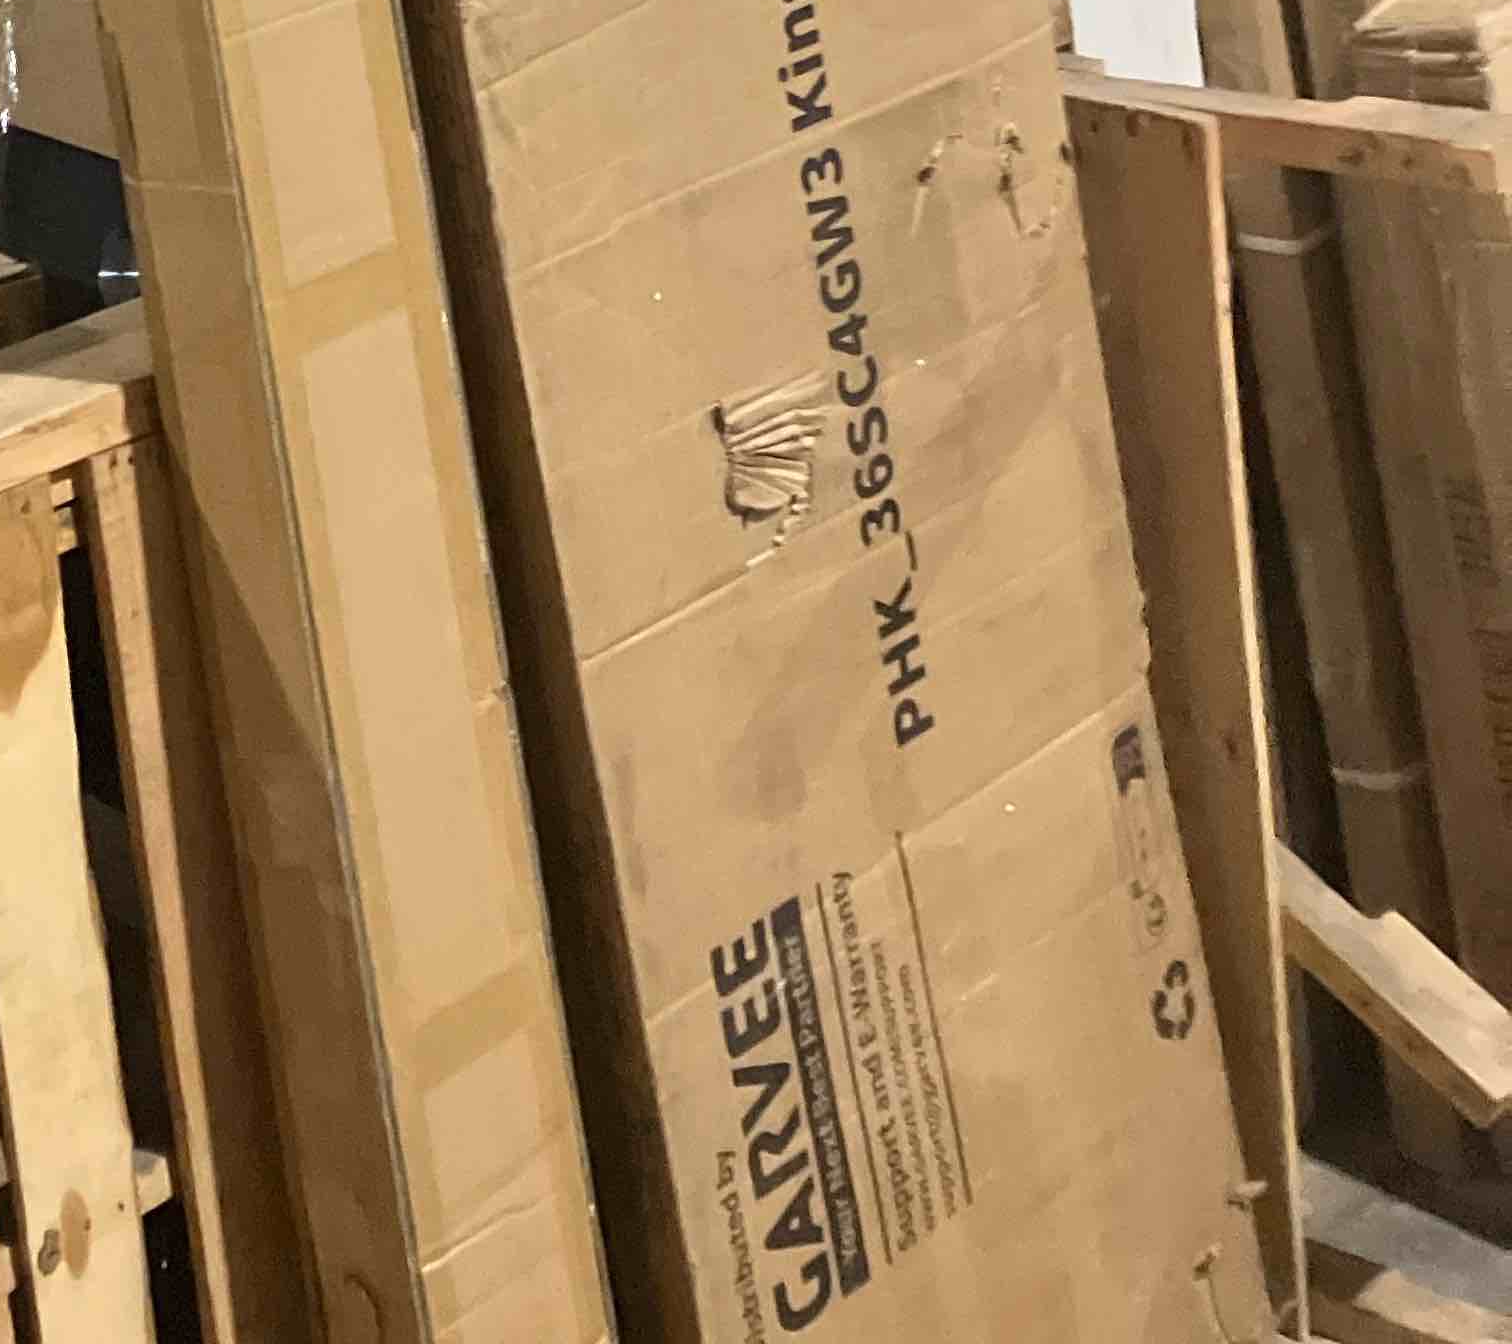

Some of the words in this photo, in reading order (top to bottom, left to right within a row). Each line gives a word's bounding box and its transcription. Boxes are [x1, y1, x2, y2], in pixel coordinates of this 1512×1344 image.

[799, 145, 935, 748] PHK_36SC4GW3
[784, 935, 818, 1047] Partner
[804, 1052, 830, 1115] Best
[861, 1051, 890, 1110] and
[709, 918, 833, 1332] GARVEE
[818, 1117, 842, 1194] Next
[715, 1149, 737, 1192] by
[878, 1115, 918, 1252] Support
[834, 1199, 858, 1257] Your
